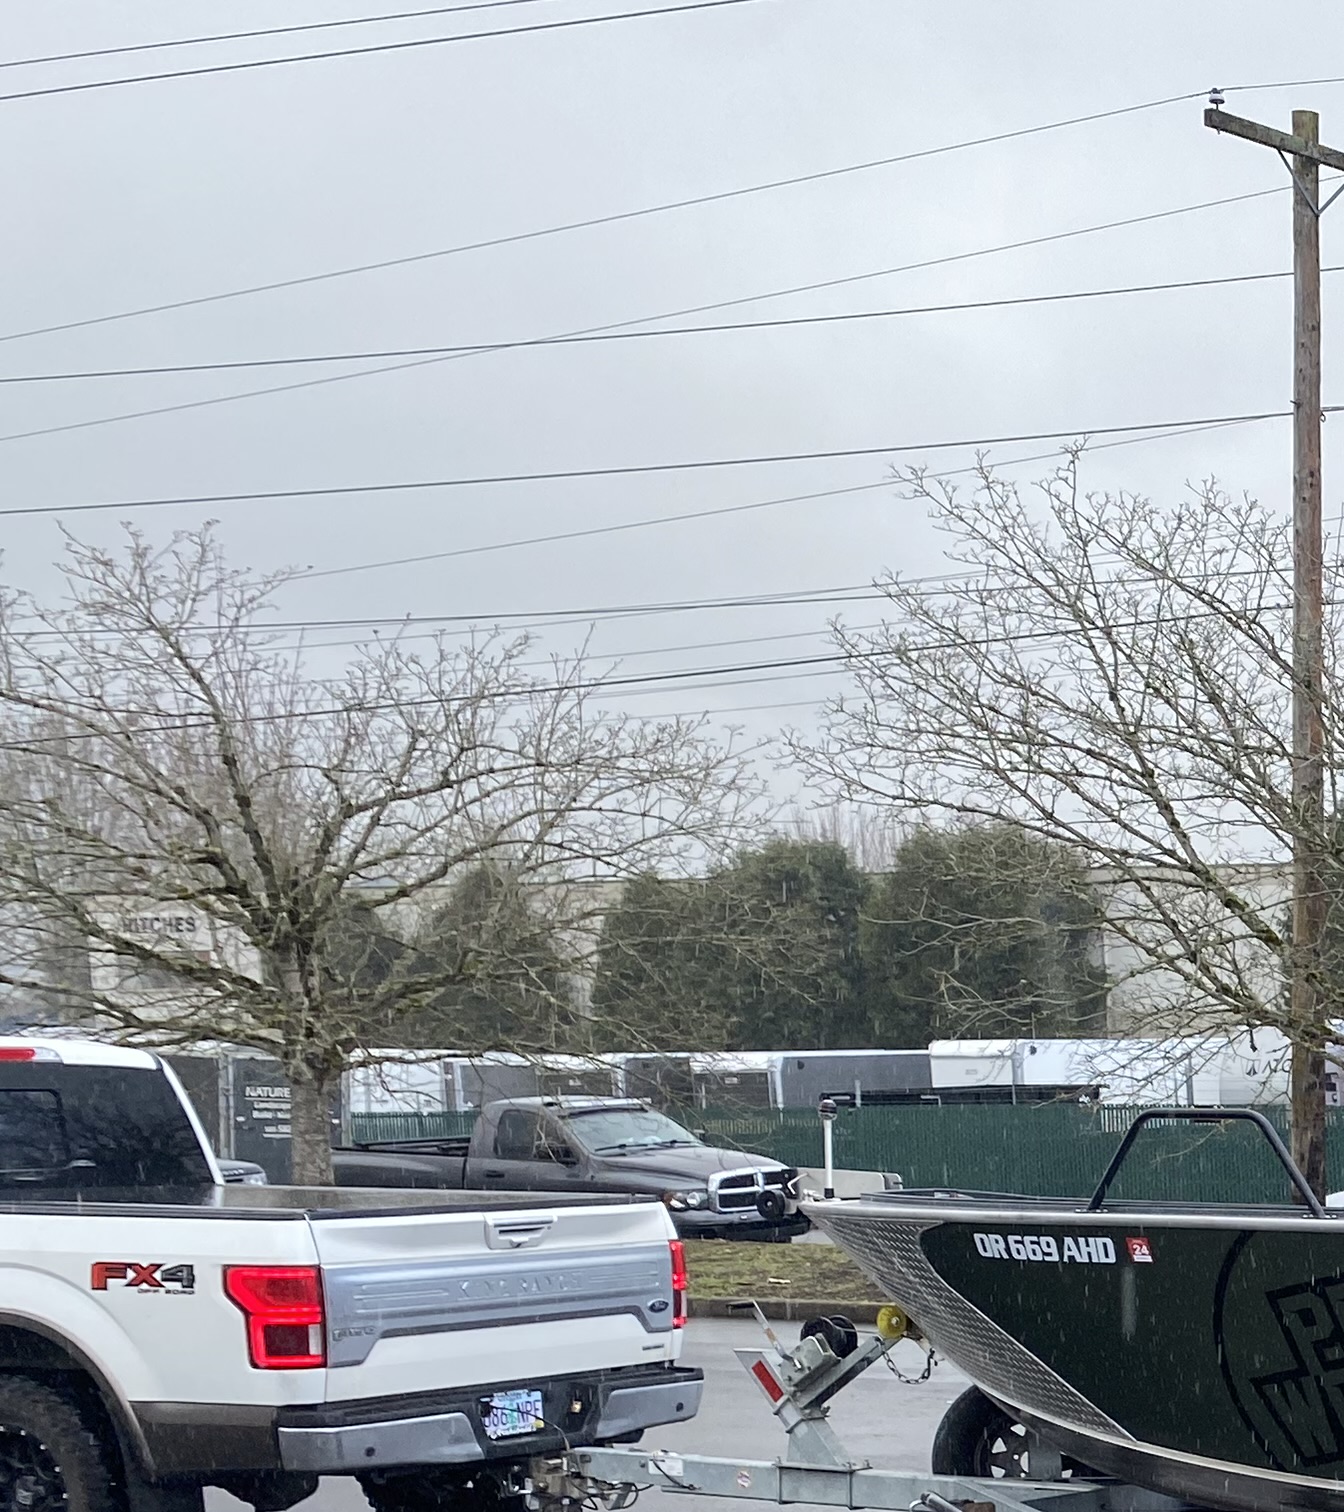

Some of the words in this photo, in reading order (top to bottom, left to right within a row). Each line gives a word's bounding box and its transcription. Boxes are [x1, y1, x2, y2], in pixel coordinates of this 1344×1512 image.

[973, 1233, 1010, 1260] OR
[1007, 1235, 1061, 1262] 669
[1063, 1236, 1117, 1264] AHD
[1132, 1244, 1150, 1255] 24
[91, 1261, 196, 1291] FX4
